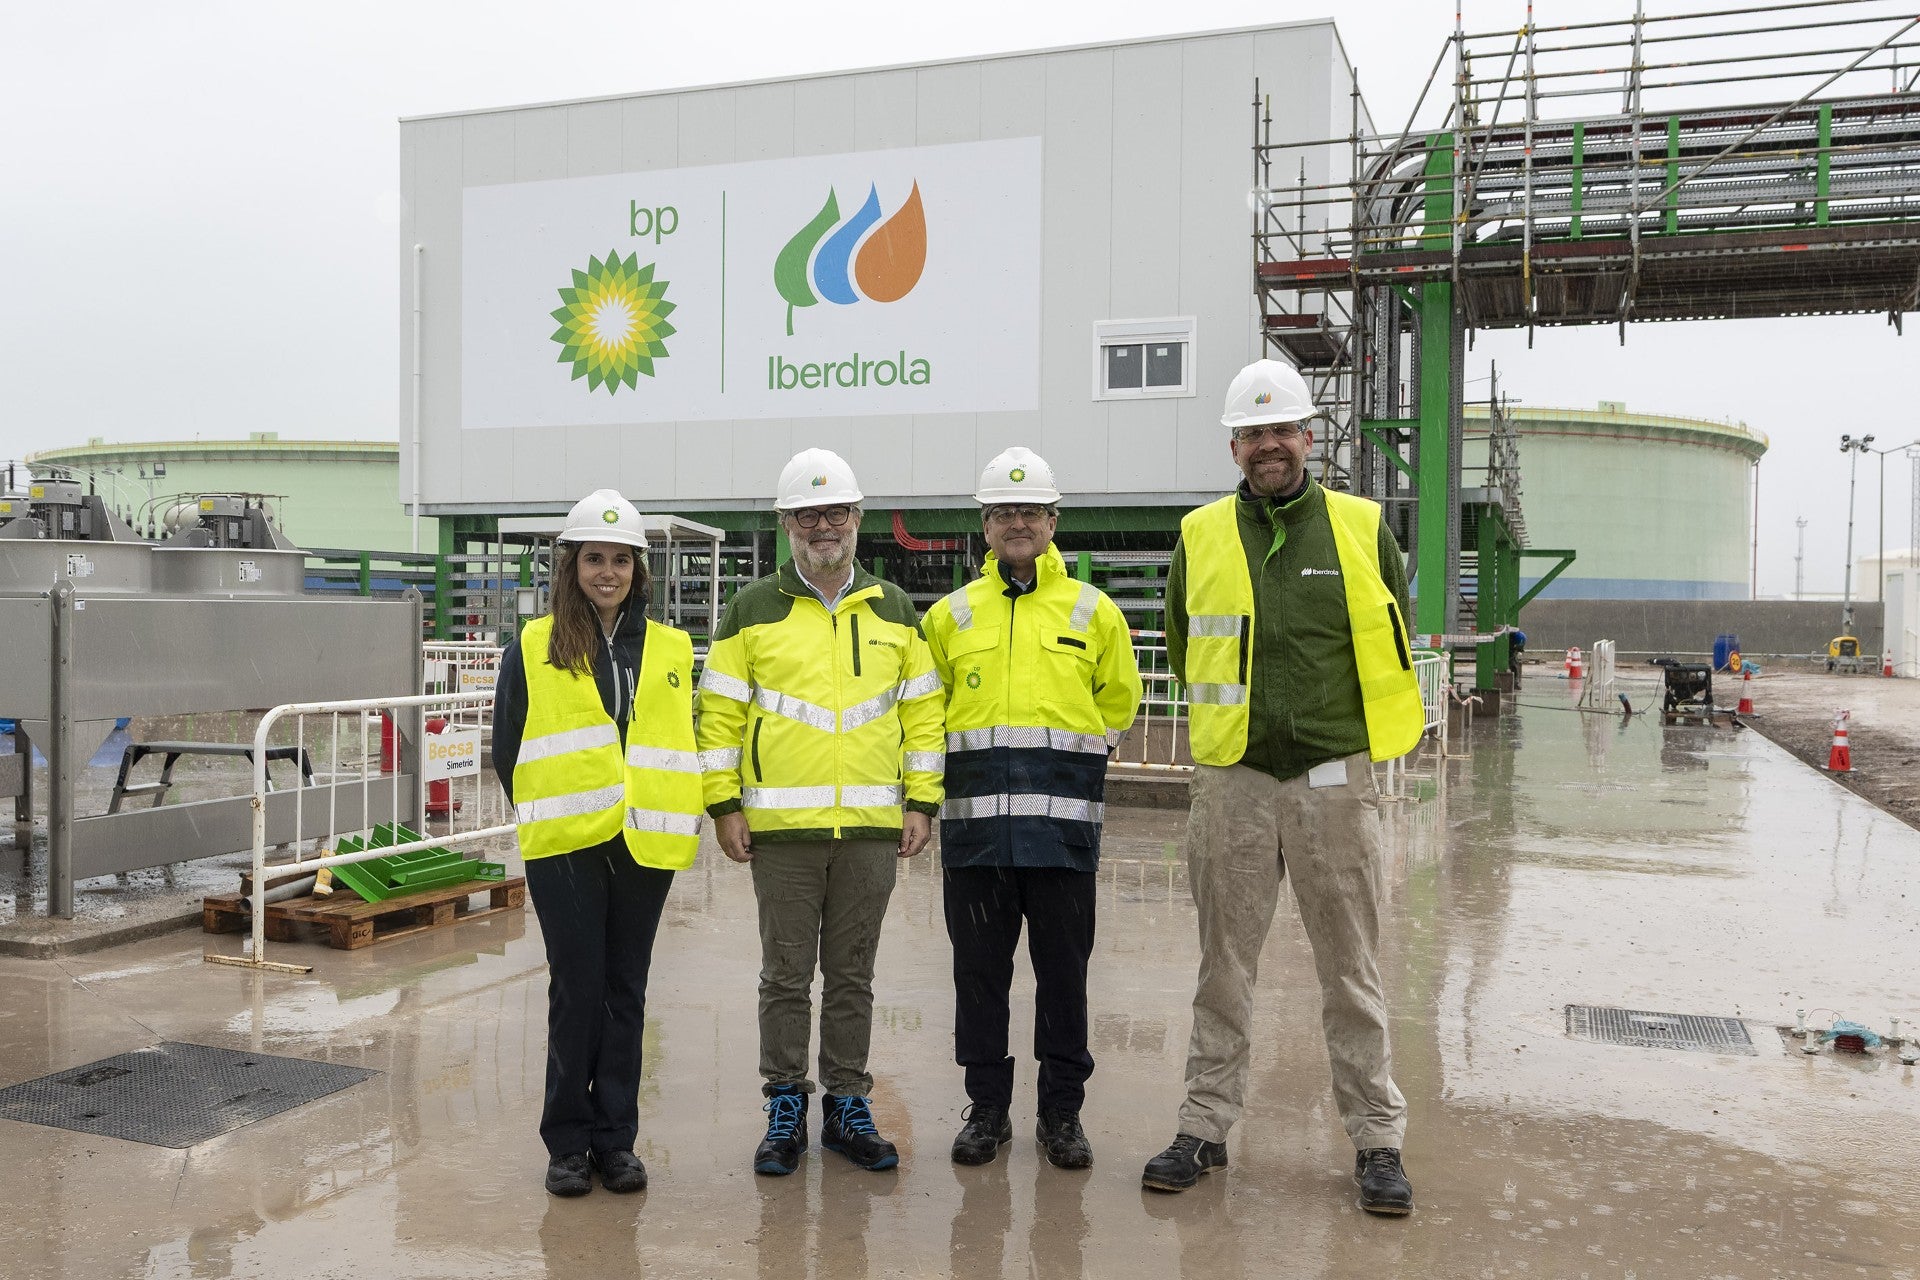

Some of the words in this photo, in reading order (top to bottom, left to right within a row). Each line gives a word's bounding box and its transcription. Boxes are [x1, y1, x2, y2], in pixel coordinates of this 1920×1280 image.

[630, 199, 679, 245] bp
[768, 350, 931, 390] Iberdrola
[462, 674, 495, 684] Becsa
[428, 741, 474, 761] Becsa
[446, 759, 474, 770] Simetria
